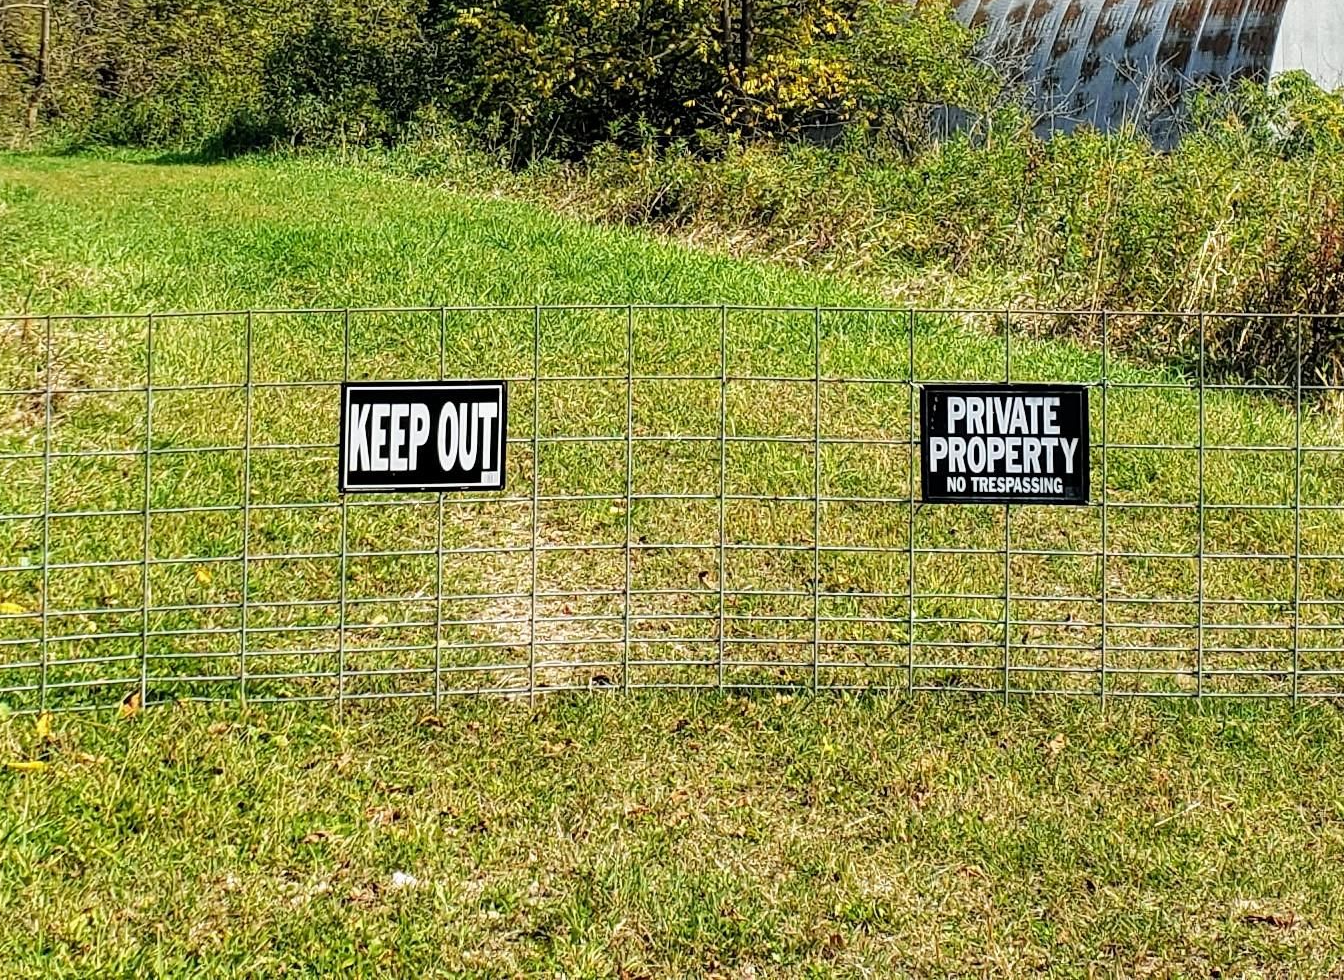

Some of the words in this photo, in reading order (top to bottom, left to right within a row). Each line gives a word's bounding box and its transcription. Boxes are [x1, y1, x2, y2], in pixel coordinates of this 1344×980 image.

[947, 396, 1061, 435] PRIVATE
[349, 403, 431, 472] KEEP
[437, 401, 498, 472] OUT
[929, 436, 1079, 474] PROPERTY
[947, 476, 967, 493] NO
[971, 476, 1064, 494] TRESPASSING
